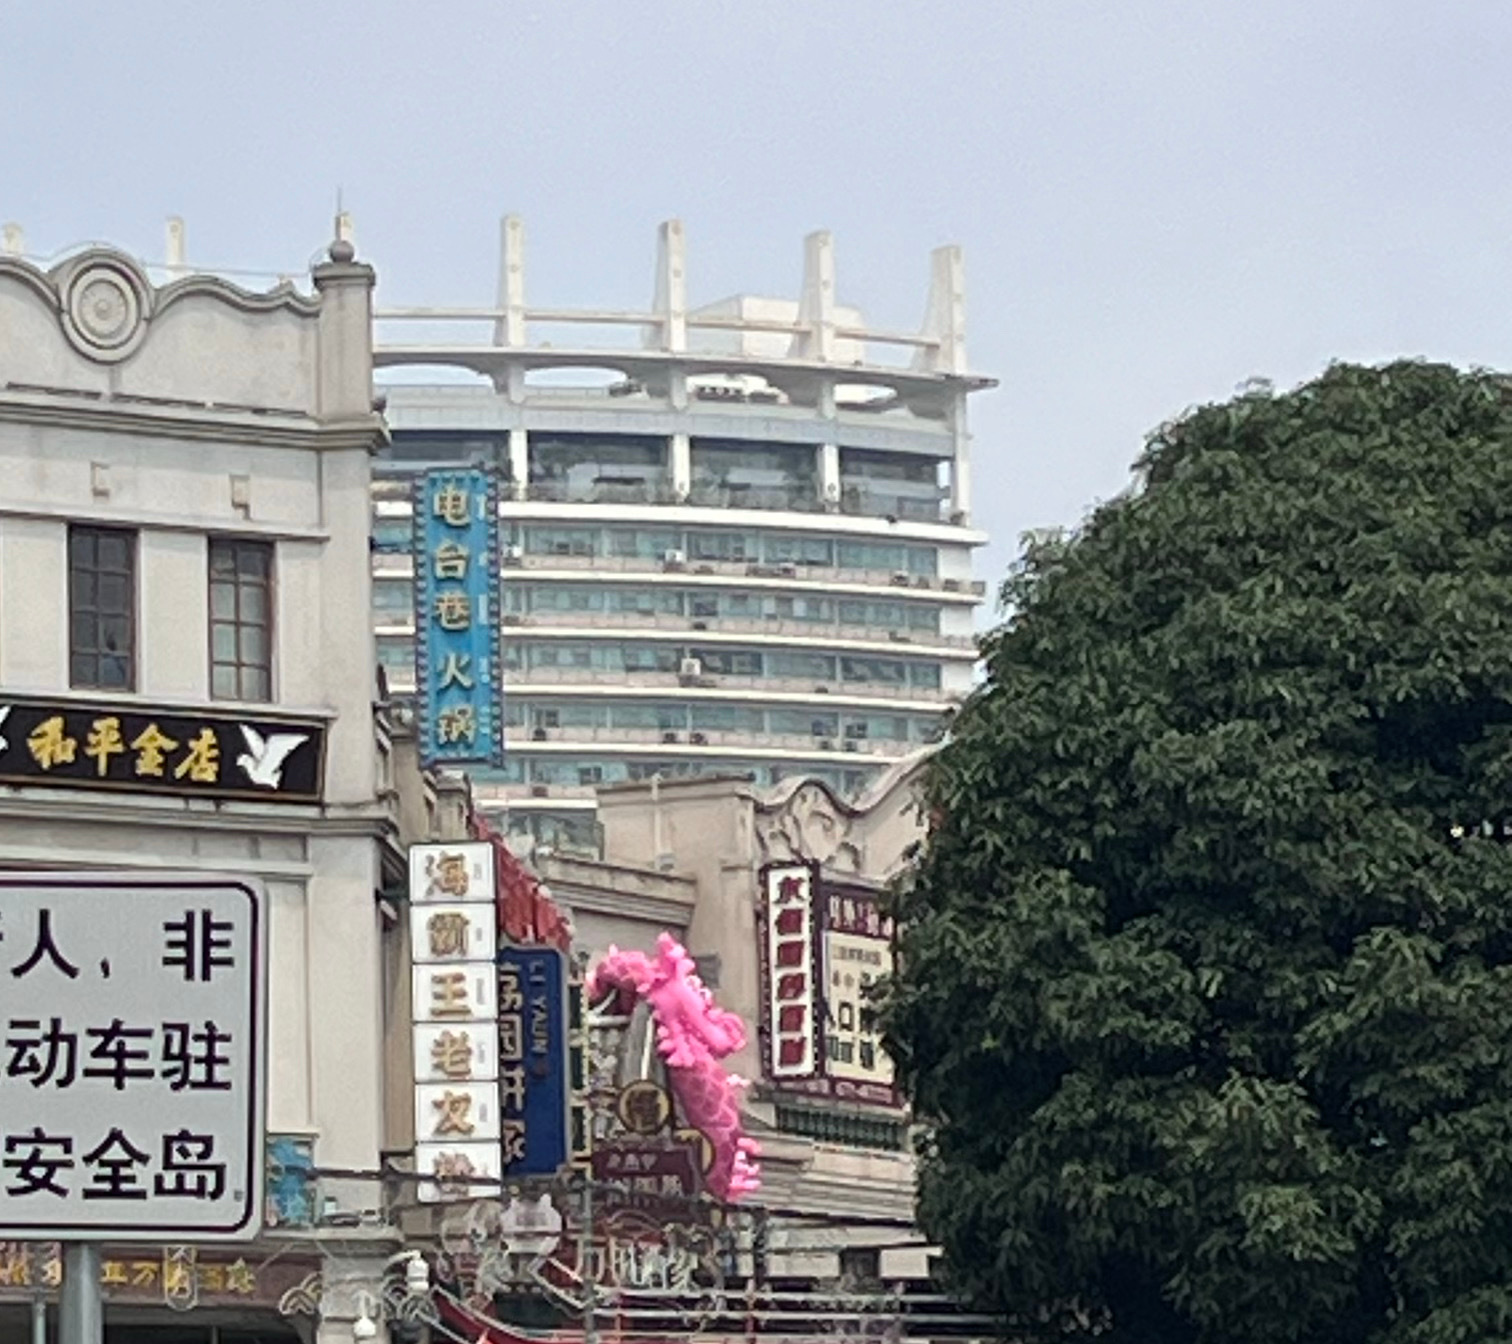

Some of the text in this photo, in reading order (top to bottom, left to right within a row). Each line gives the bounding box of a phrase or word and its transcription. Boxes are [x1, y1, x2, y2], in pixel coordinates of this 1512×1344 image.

[432, 483, 478, 747] 电台巷火锅
